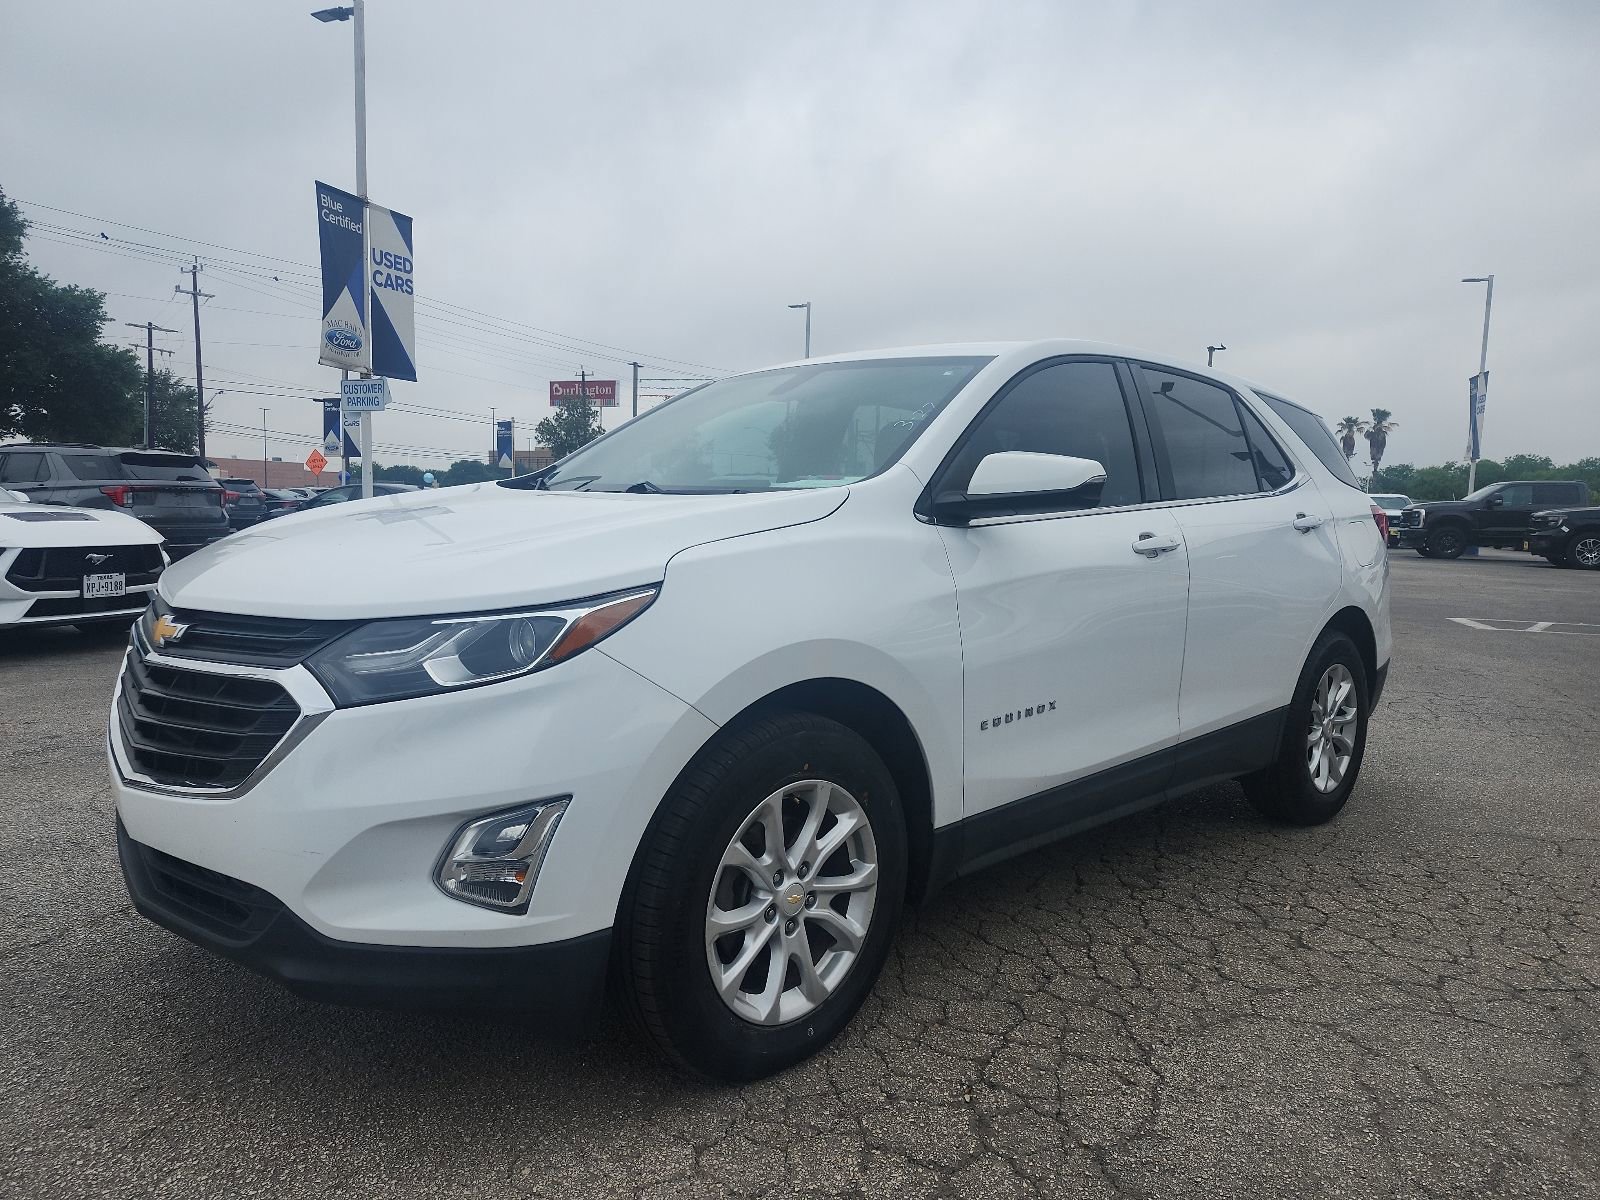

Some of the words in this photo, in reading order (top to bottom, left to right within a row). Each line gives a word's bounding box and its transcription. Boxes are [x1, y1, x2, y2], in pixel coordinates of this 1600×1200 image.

[320, 194, 343, 212] Blue
[321, 209, 363, 235] Certified
[372, 248, 414, 275] USED
[372, 270, 414, 295] CARS
[333, 330, 357, 348] Ford
[343, 384, 383, 395] CUSTOMER
[552, 383, 612, 398] Burlington
[347, 396, 380, 407] PARKING
[980, 699, 1057, 731] EQUINOX
